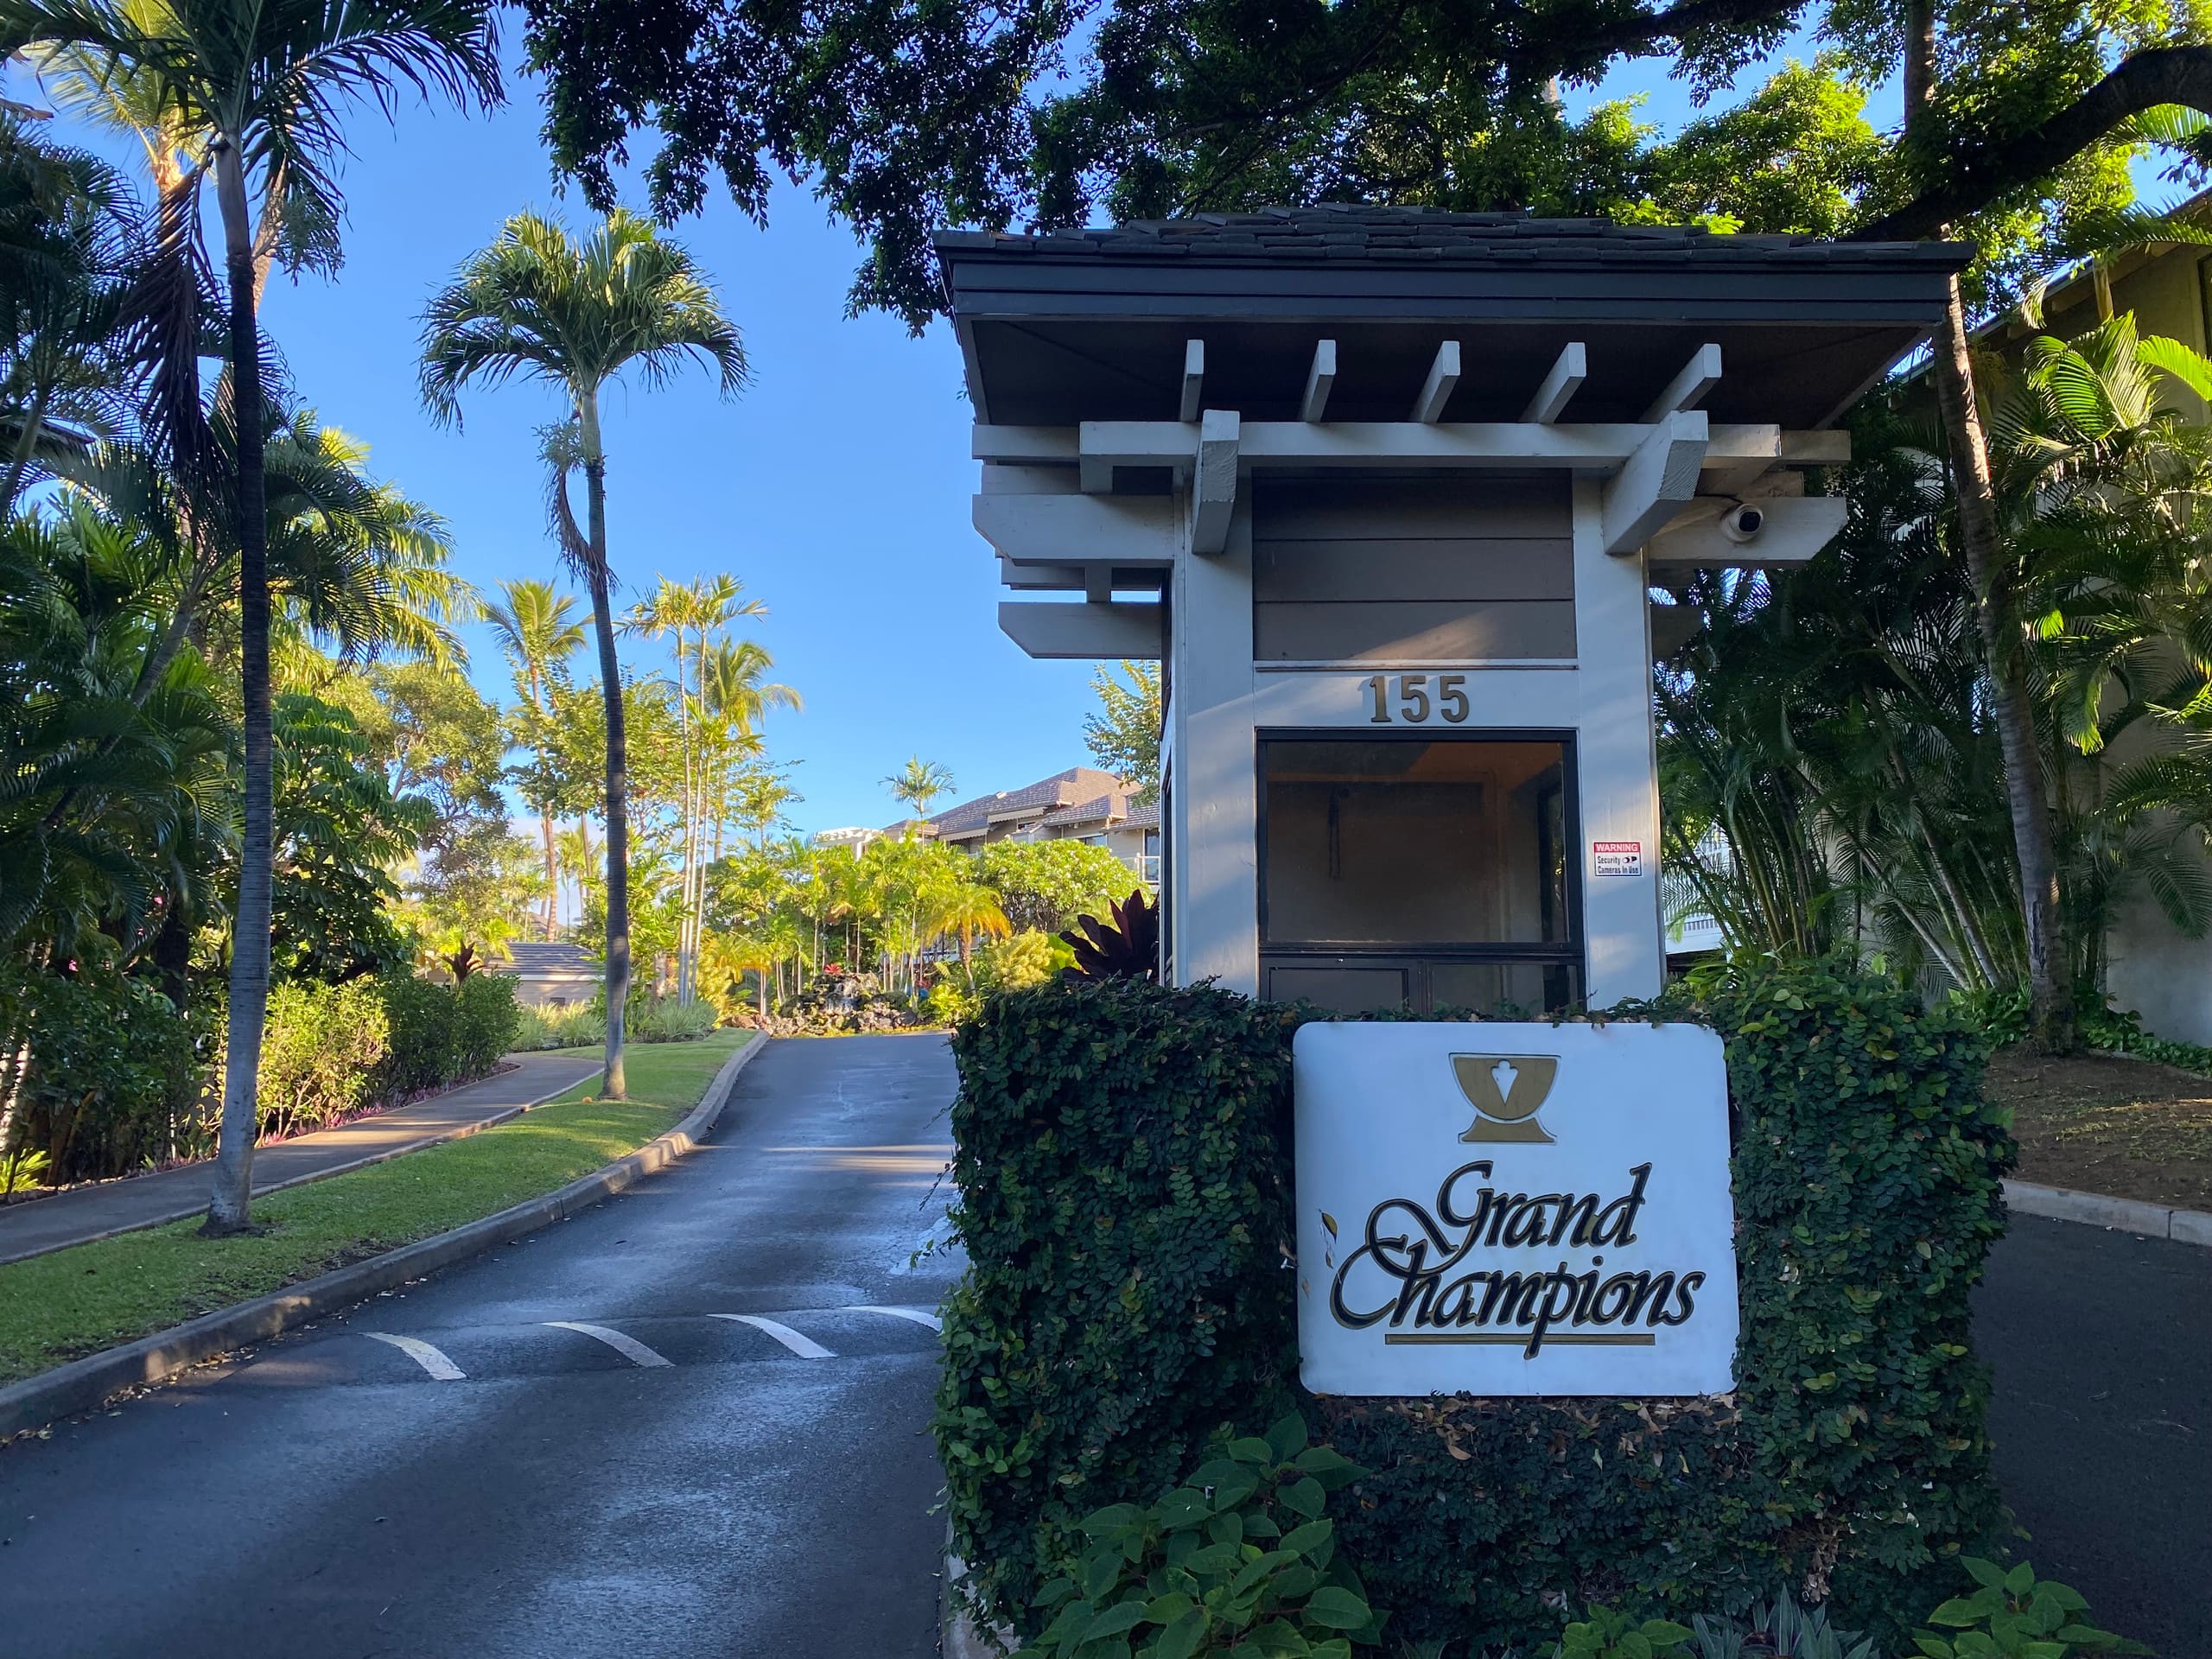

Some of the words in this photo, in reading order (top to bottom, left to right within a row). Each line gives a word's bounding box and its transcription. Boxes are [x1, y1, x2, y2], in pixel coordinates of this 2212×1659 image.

[1370, 675, 1469, 722] 155
[1596, 843, 1638, 852] WARNING
[1598, 856, 1620, 865] Security
[1365, 1160, 1653, 1274] Grand
[1329, 1234, 1707, 1360] Champions
